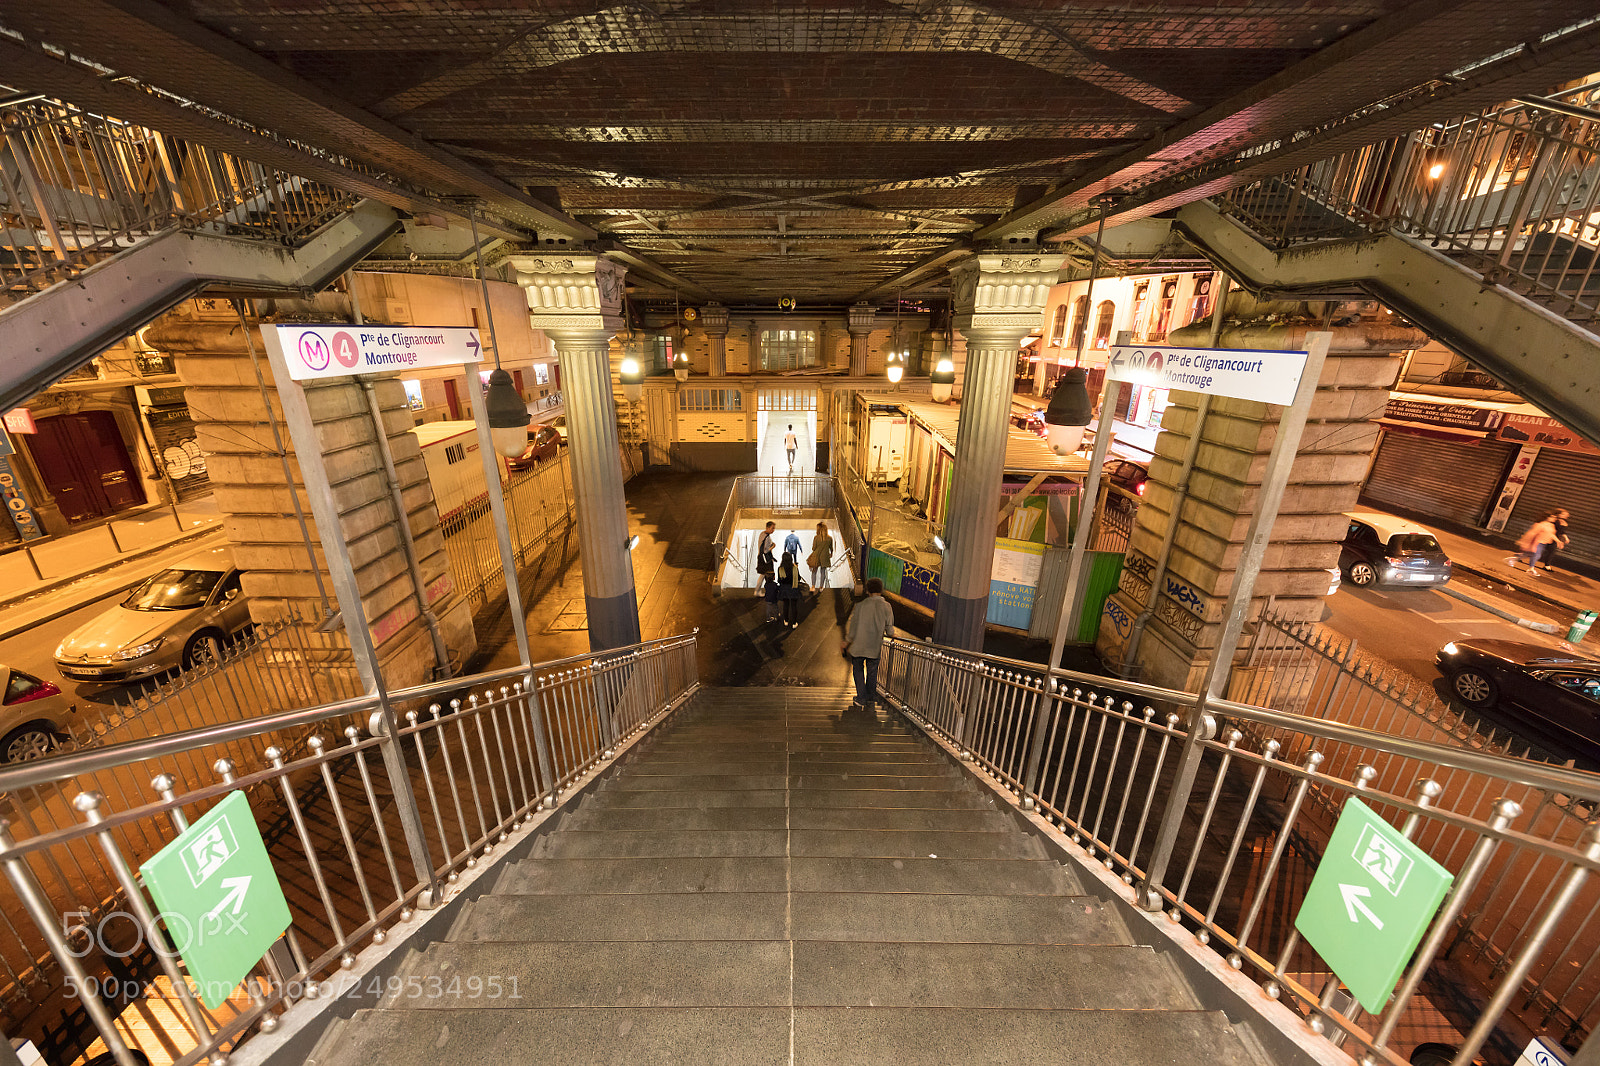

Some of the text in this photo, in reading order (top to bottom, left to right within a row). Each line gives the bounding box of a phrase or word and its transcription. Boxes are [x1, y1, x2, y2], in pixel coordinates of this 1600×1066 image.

[339, 339, 353, 361] 4
[377, 333, 390, 346] de
[391, 332, 446, 349] Clignancourt
[365, 351, 418, 366] Montrouge
[1180, 355, 1192, 368] de
[1193, 355, 1263, 374] Clignancourt
[1163, 369, 1213, 389] Montrouge
[5, 416, 27, 427] SFR
[1507, 413, 1543, 426] BAZAR
[992, 590, 1020, 600] rénove
